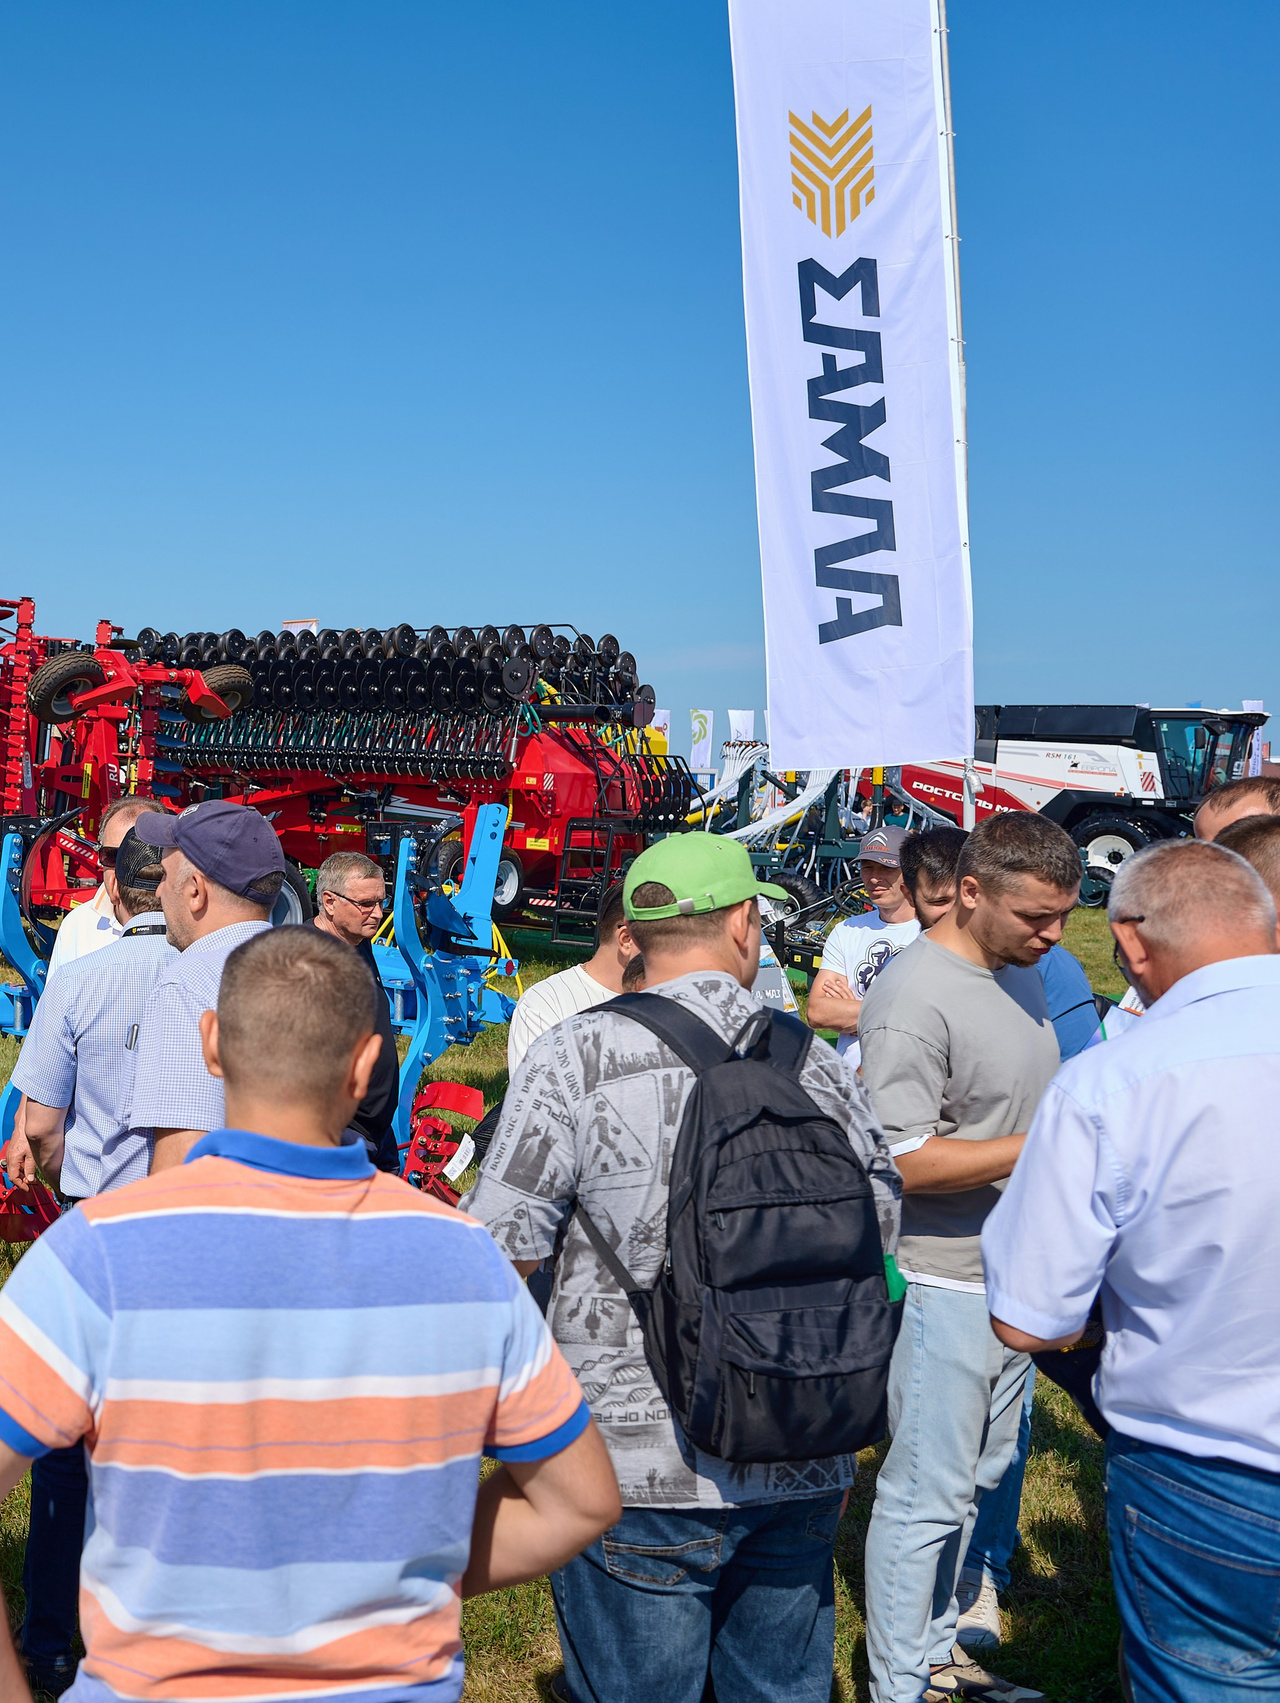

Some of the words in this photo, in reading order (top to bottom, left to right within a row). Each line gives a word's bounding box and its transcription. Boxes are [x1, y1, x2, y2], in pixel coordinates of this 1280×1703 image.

[532, 1098, 576, 1131] OPLE
[591, 1412, 613, 1424] PE
[617, 1411, 639, 1423] OF
